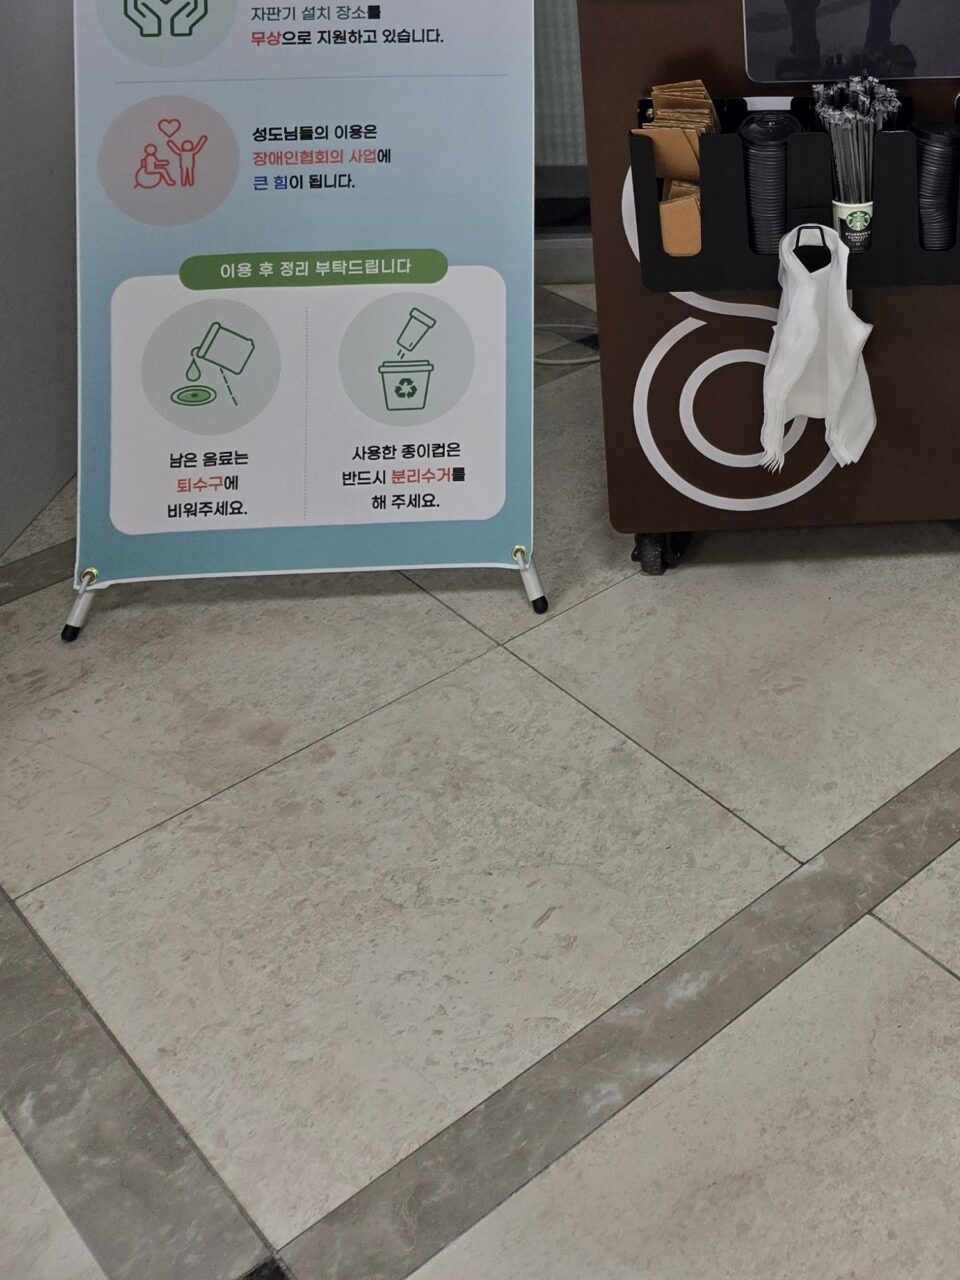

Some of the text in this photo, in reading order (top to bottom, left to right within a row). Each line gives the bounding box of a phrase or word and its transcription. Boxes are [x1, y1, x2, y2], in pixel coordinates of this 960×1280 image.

[250, 5, 381, 21] 자판기 설치 장소를
[250, 28, 444, 46] 무상으로 지원하고 있습니다.
[252, 124, 378, 142] 성도님들의 이용은
[252, 148, 391, 166] 장애인협회의 사업에
[253, 173, 355, 191] 큰 힘이 됩니다.
[220, 258, 411, 278] 이용 후 정리 부탁드립니다
[169, 450, 249, 469] 남은 음료는
[351, 442, 461, 461] 사용한 종이컵은
[176, 475, 239, 493] 퇴수구에
[342, 466, 466, 486] 반드시 분리수거를
[167, 500, 248, 519] 비워주세요.
[371, 493, 440, 510] 해 주세요.
